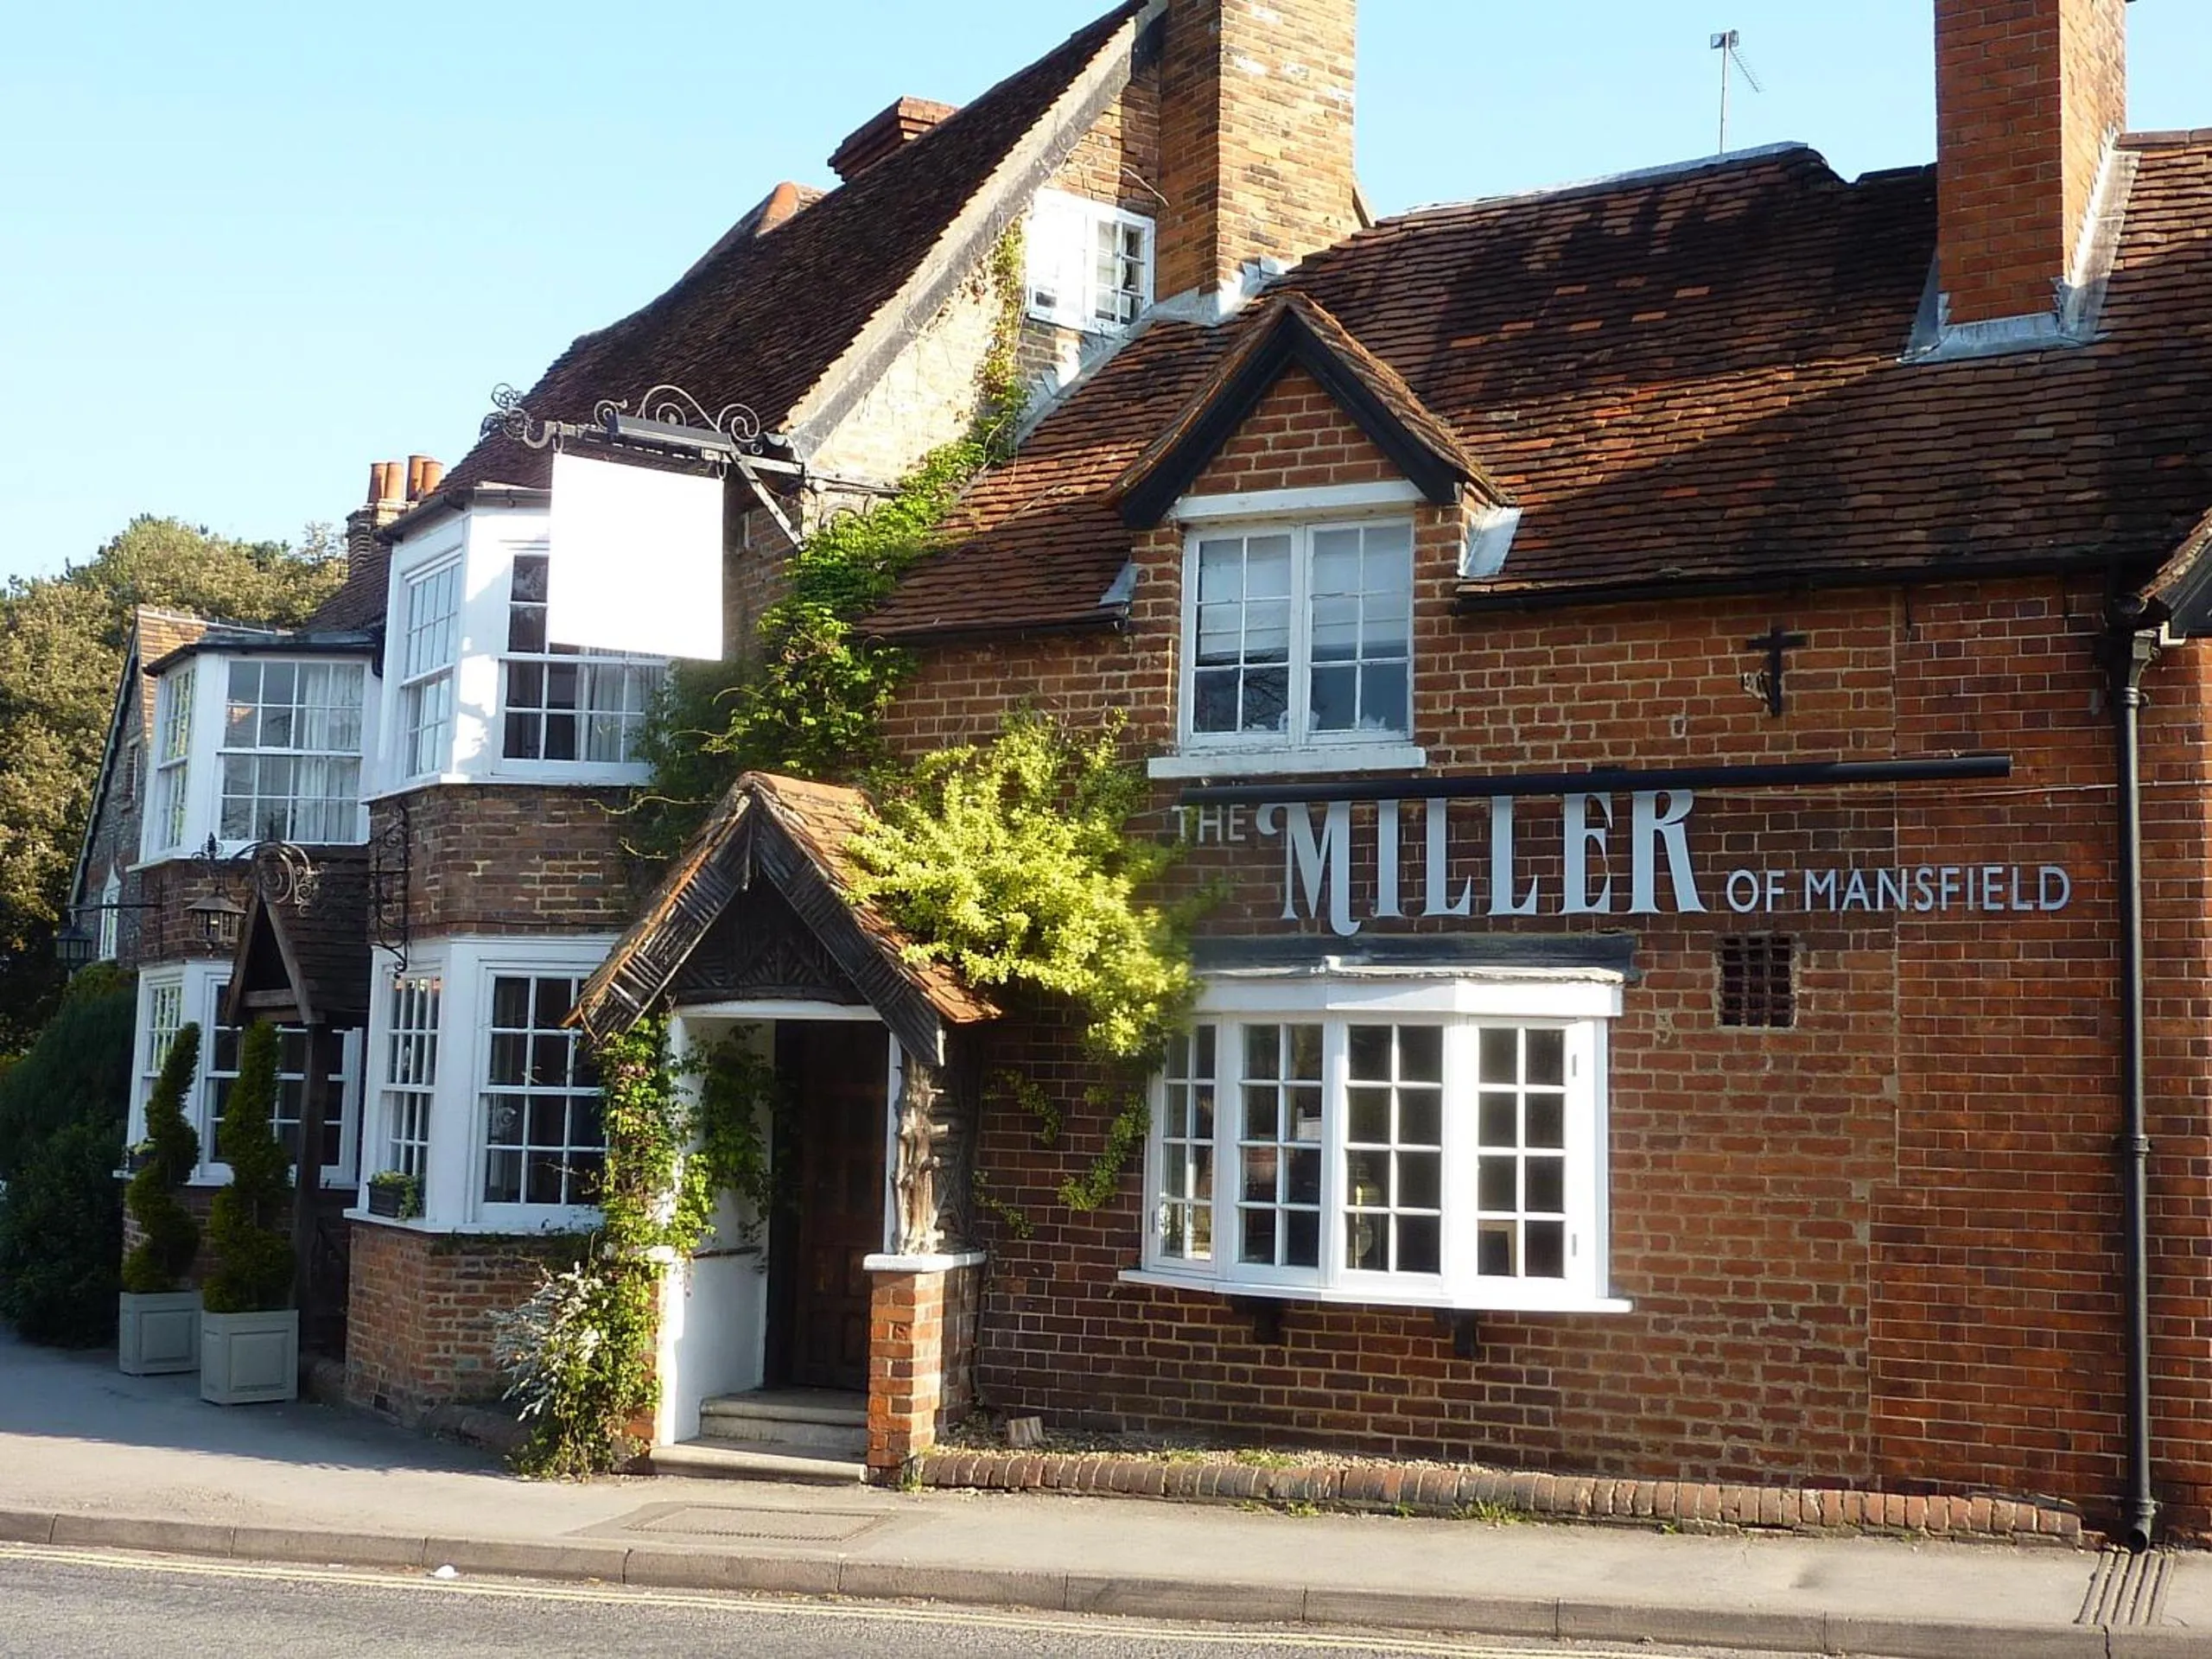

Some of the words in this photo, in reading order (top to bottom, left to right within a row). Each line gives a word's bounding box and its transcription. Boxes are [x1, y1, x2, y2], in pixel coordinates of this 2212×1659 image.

[1171, 804, 1246, 842] THE
[1256, 788, 1709, 938] MILLER
[1726, 868, 1786, 913] OF
[1804, 866, 2071, 913] MANSFIELD
